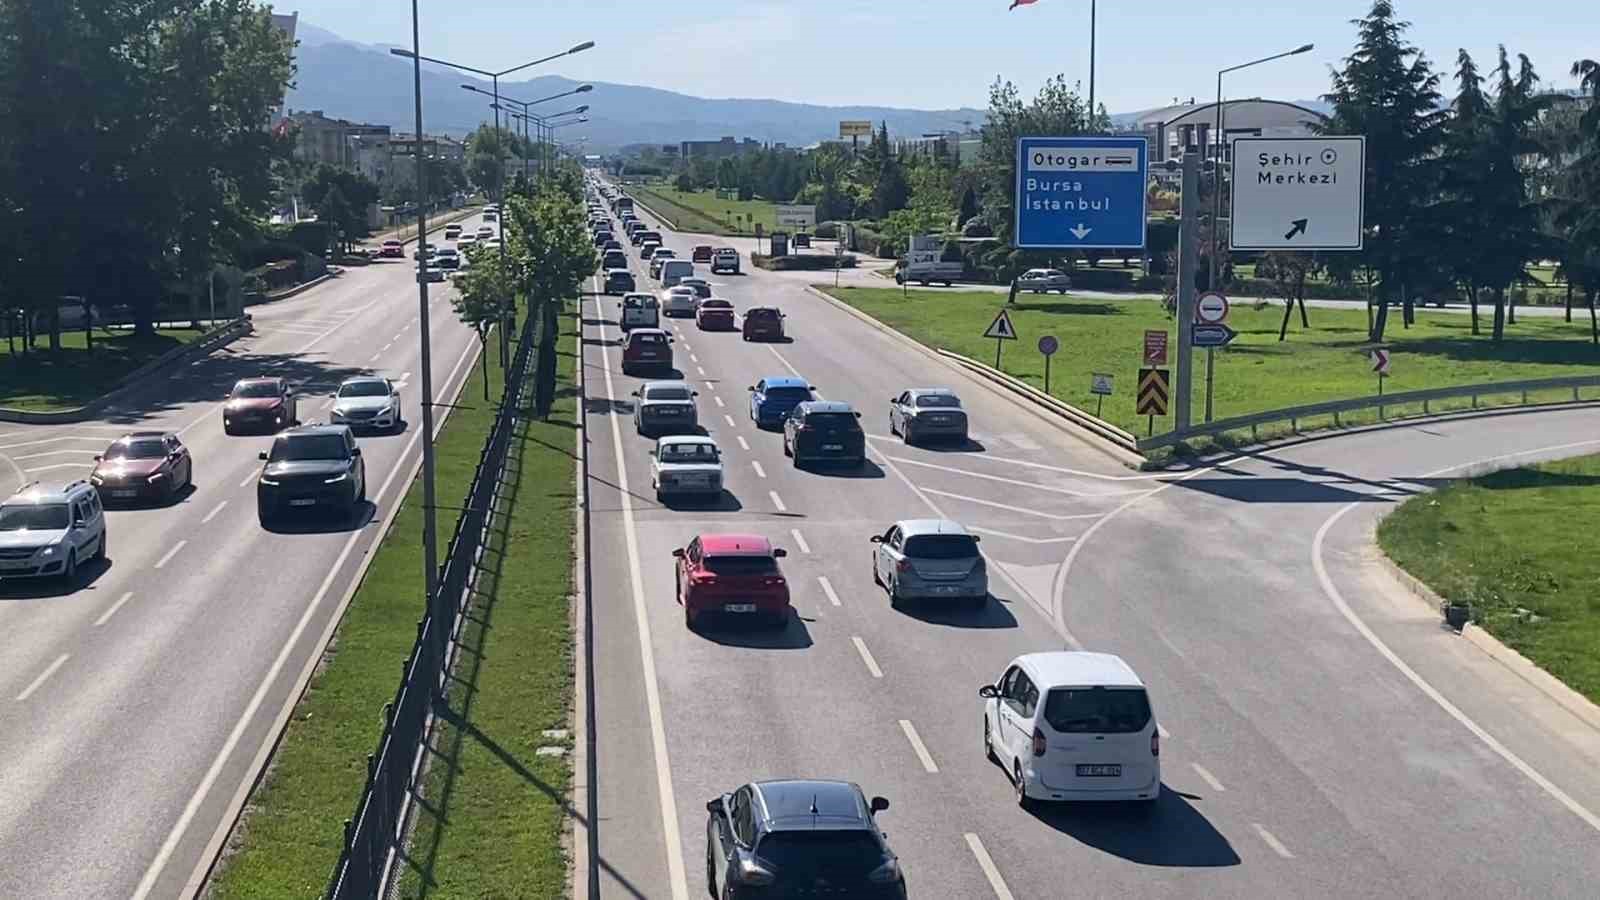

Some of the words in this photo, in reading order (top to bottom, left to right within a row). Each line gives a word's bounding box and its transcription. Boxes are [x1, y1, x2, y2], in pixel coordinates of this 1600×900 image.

[1034, 153, 1101, 169] Otogar
[1258, 152, 1313, 168] Şehir
[1026, 178, 1082, 192] Bursa
[1258, 171, 1337, 185] Merkezi
[1026, 193, 1110, 211] İstanbul
